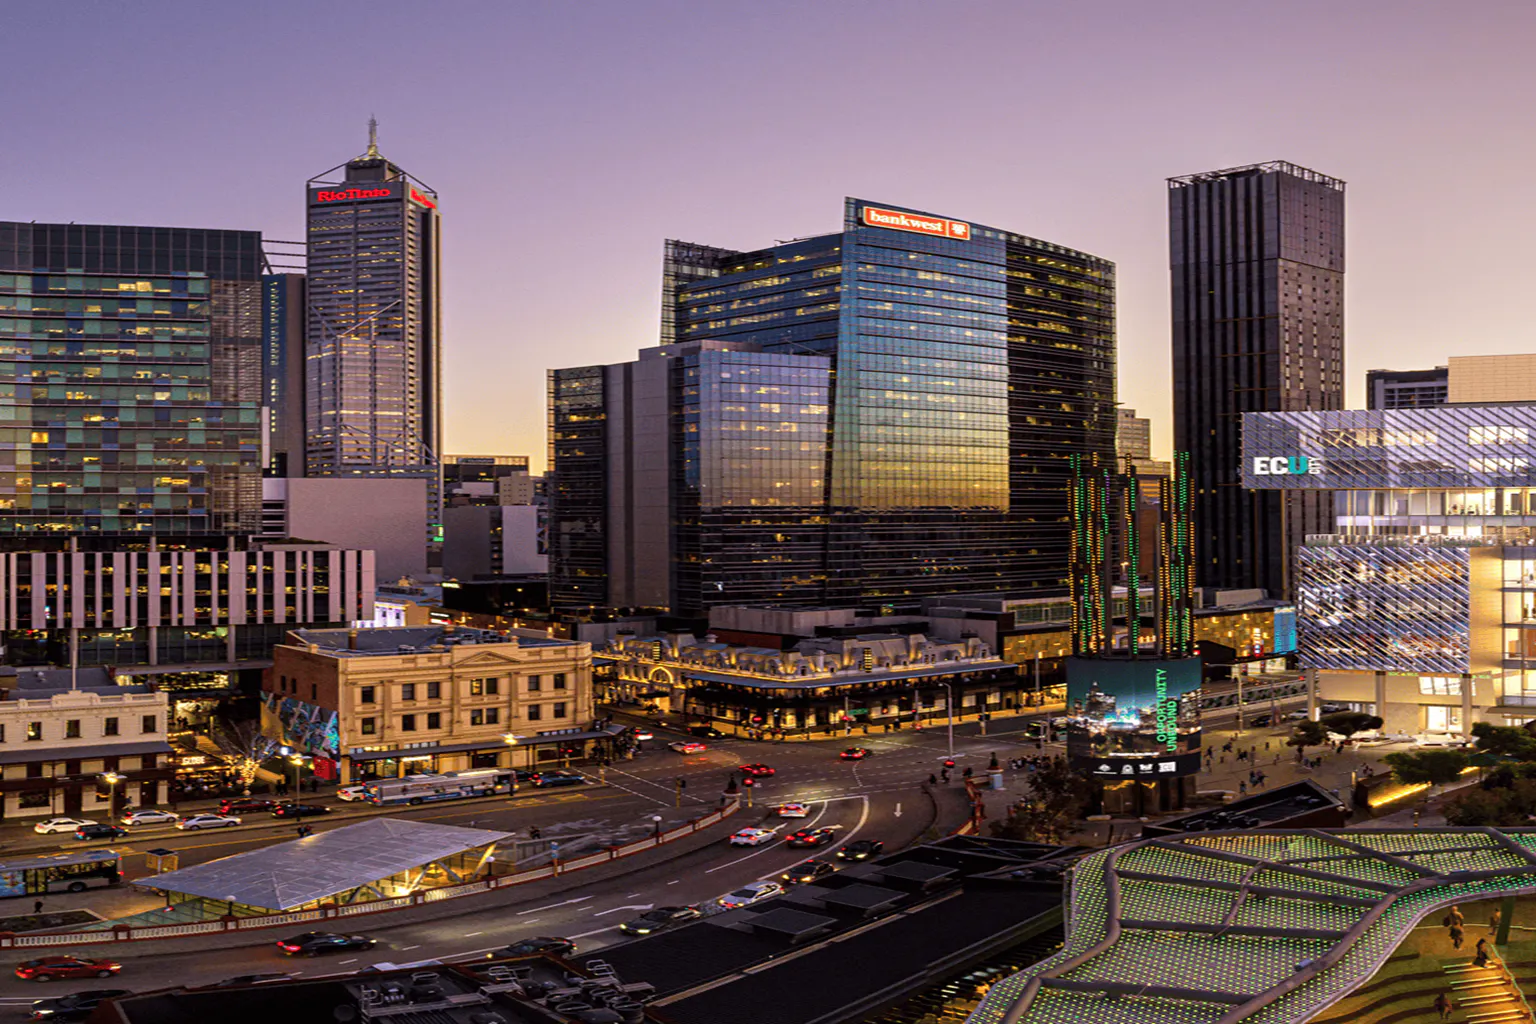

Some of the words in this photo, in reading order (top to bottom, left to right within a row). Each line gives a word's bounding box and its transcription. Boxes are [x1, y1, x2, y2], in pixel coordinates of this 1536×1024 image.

[870, 210, 943, 232] bankwest
[1253, 455, 1308, 475] ECU
[1155, 668, 1167, 743] OPPORTUNITY
[1166, 700, 1178, 752] UNBOUND
